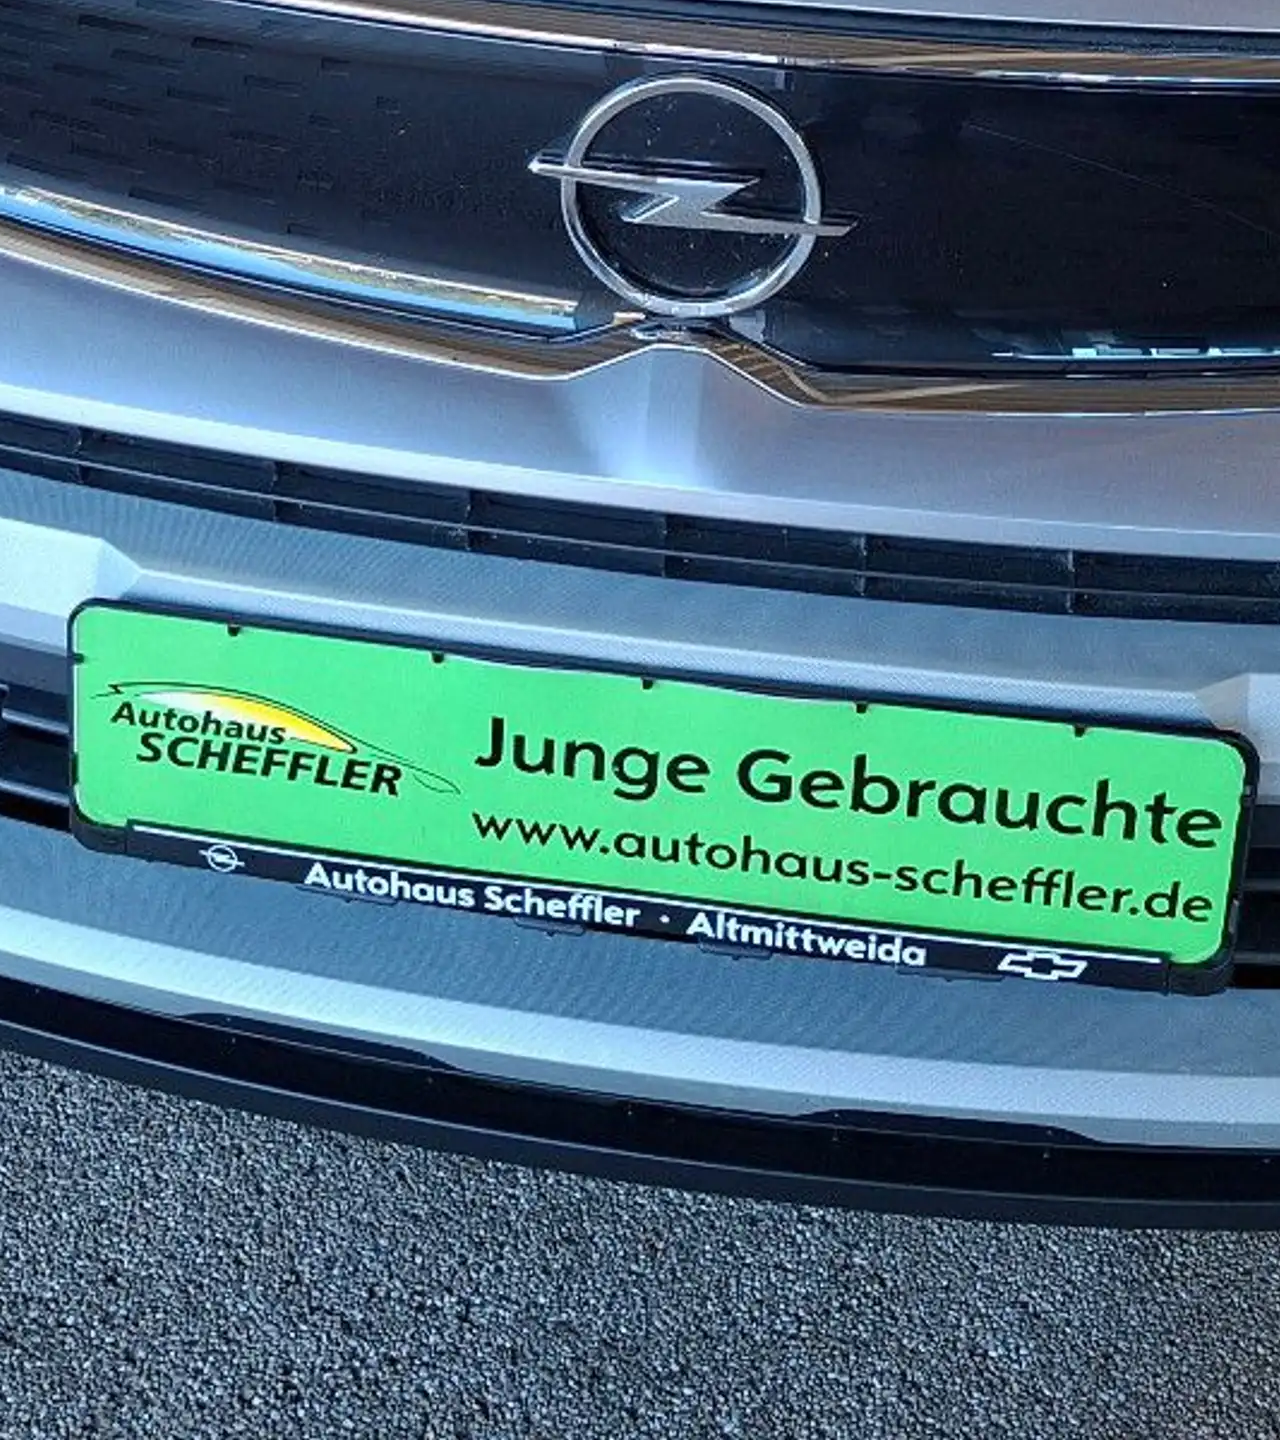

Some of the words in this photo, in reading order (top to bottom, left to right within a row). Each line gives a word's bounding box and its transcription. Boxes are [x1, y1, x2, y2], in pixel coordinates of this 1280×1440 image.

[111, 701, 286, 746] Autohaus
[136, 732, 404, 797] SCHEFFLER
[474, 716, 710, 801] Junge
[736, 748, 1222, 849] Gebrauchte
[304, 862, 476, 908] Autohaus
[484, 885, 641, 928] Scheffler
[685, 911, 927, 967] Altmittweida
[472, 811, 1214, 922] www.autohaus-scheffler.de
